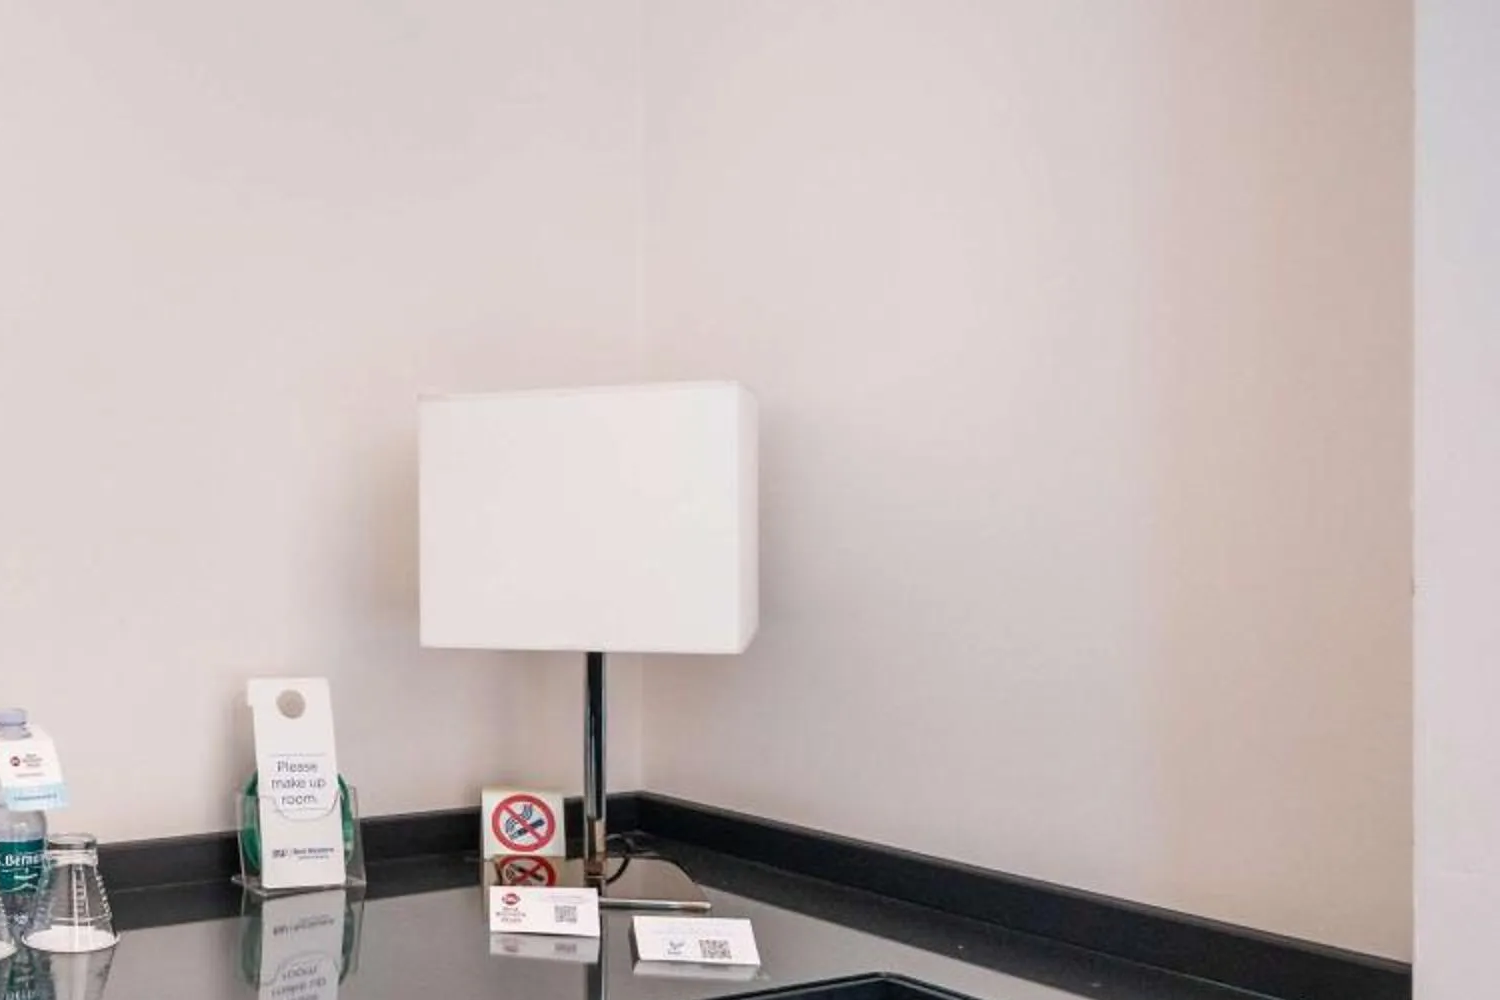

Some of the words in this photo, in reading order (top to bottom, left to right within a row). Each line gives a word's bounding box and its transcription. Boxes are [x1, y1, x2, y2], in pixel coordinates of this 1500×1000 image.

[276, 760, 317, 773] Please
[271, 778, 306, 790] make
[309, 779, 327, 790] up
